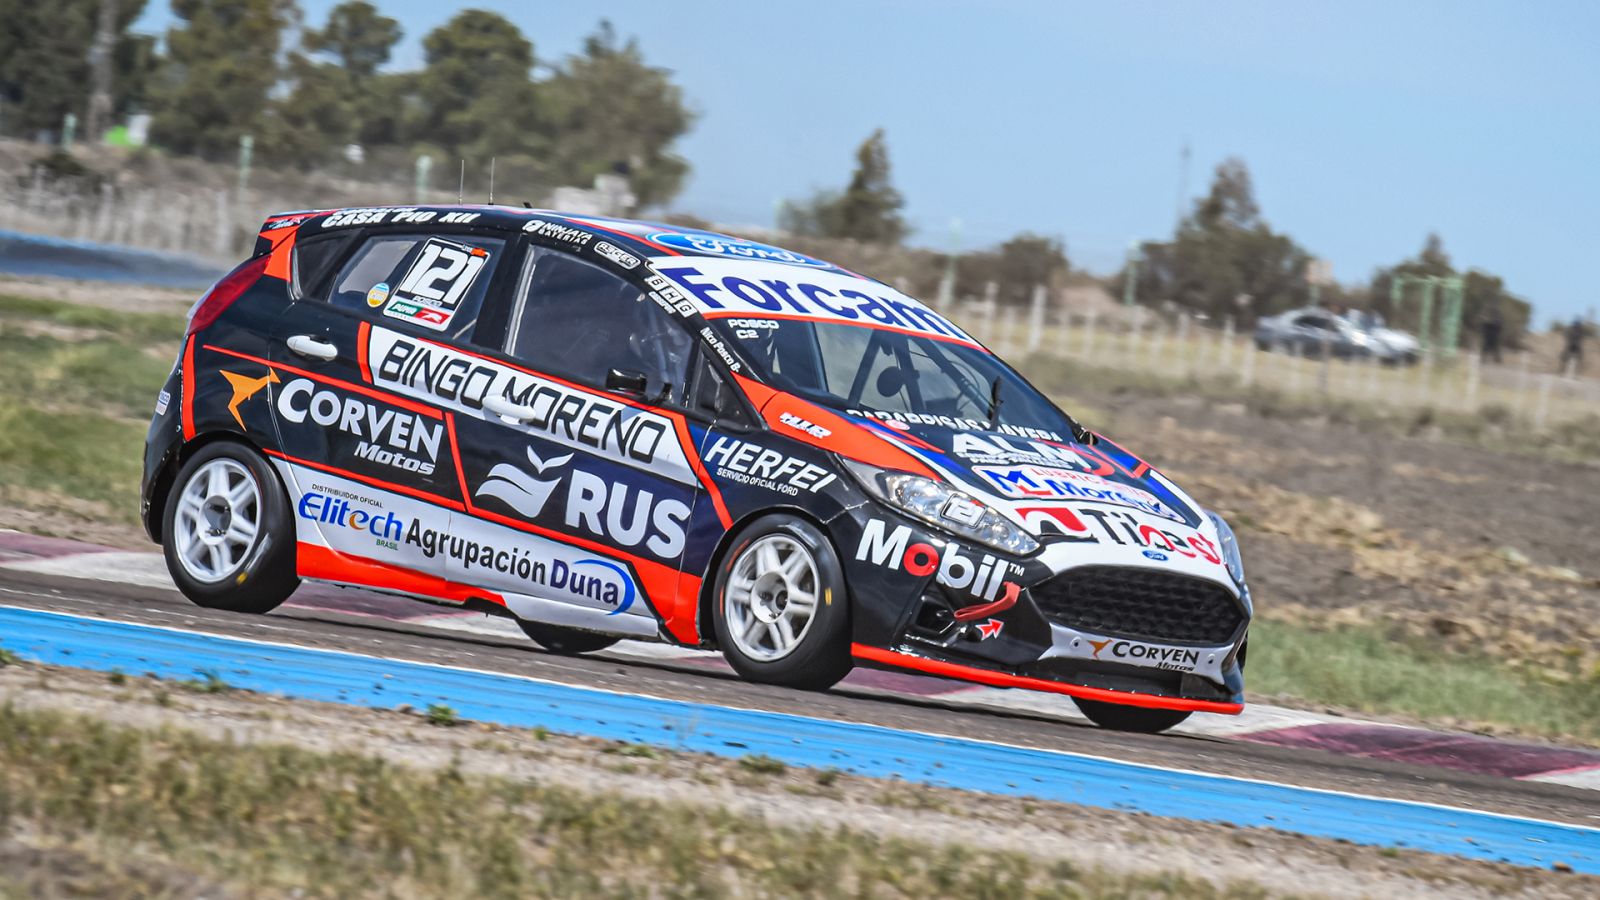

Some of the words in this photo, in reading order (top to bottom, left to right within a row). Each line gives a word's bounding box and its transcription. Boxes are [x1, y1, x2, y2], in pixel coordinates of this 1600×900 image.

[321, 211, 387, 228] CASA
[391, 211, 437, 223] PIO
[439, 212, 481, 223] XII
[538, 229, 588, 245] BATERIAS
[684, 236, 805, 263] Ford
[400, 243, 485, 305] 121
[656, 267, 970, 341] Forcam
[728, 319, 779, 329] POSCO
[379, 340, 497, 411] BINGO
[500, 377, 667, 464] MORENO
[277, 378, 443, 463] CORVEN
[354, 440, 436, 475] Motos
[704, 437, 837, 493] HERFEI
[312, 484, 360, 501] DISTRIBUIDOR
[360, 497, 383, 508] OFICIAL
[716, 468, 750, 484] SERVICIO
[749, 477, 777, 491] OFICIAL
[777, 483, 798, 497] FORD
[299, 492, 403, 541] Elitech
[564, 469, 692, 559] RUS
[376, 538, 399, 551] BRASIL
[405, 518, 547, 586] Agrupación
[550, 559, 620, 606] Duna
[855, 518, 1010, 602] Mobil
[1112, 641, 1200, 665] CORVEN
[1156, 662, 1194, 672] Motos
